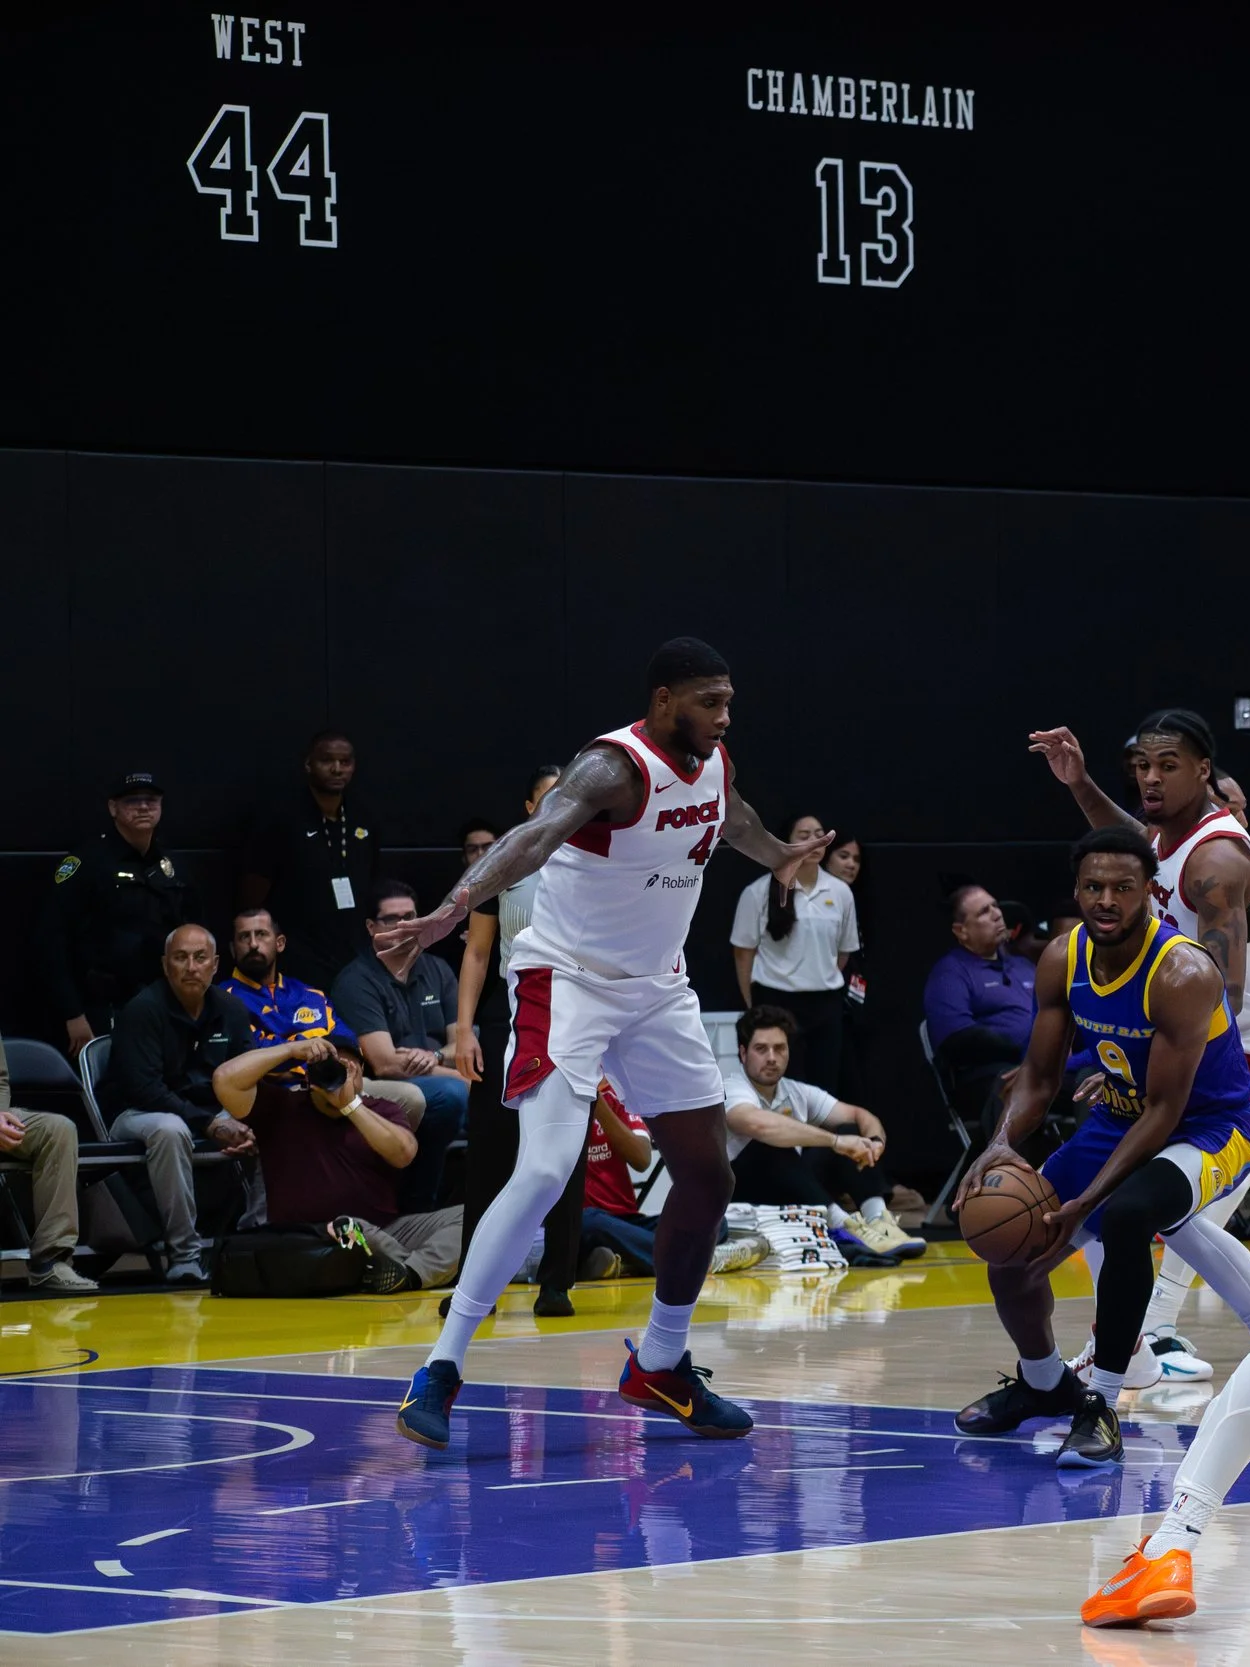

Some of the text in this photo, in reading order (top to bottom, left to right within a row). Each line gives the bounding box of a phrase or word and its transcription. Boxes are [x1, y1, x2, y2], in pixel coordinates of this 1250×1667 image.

[211, 13, 306, 67] WEST
[747, 68, 975, 131] CHAMBERLAIN
[186, 104, 338, 249] 44
[815, 157, 915, 289] 13
[655, 796, 720, 832] FORCE
[1072, 1010, 1156, 1039] OUTH BAY
[1096, 1039, 1137, 1086] 9
